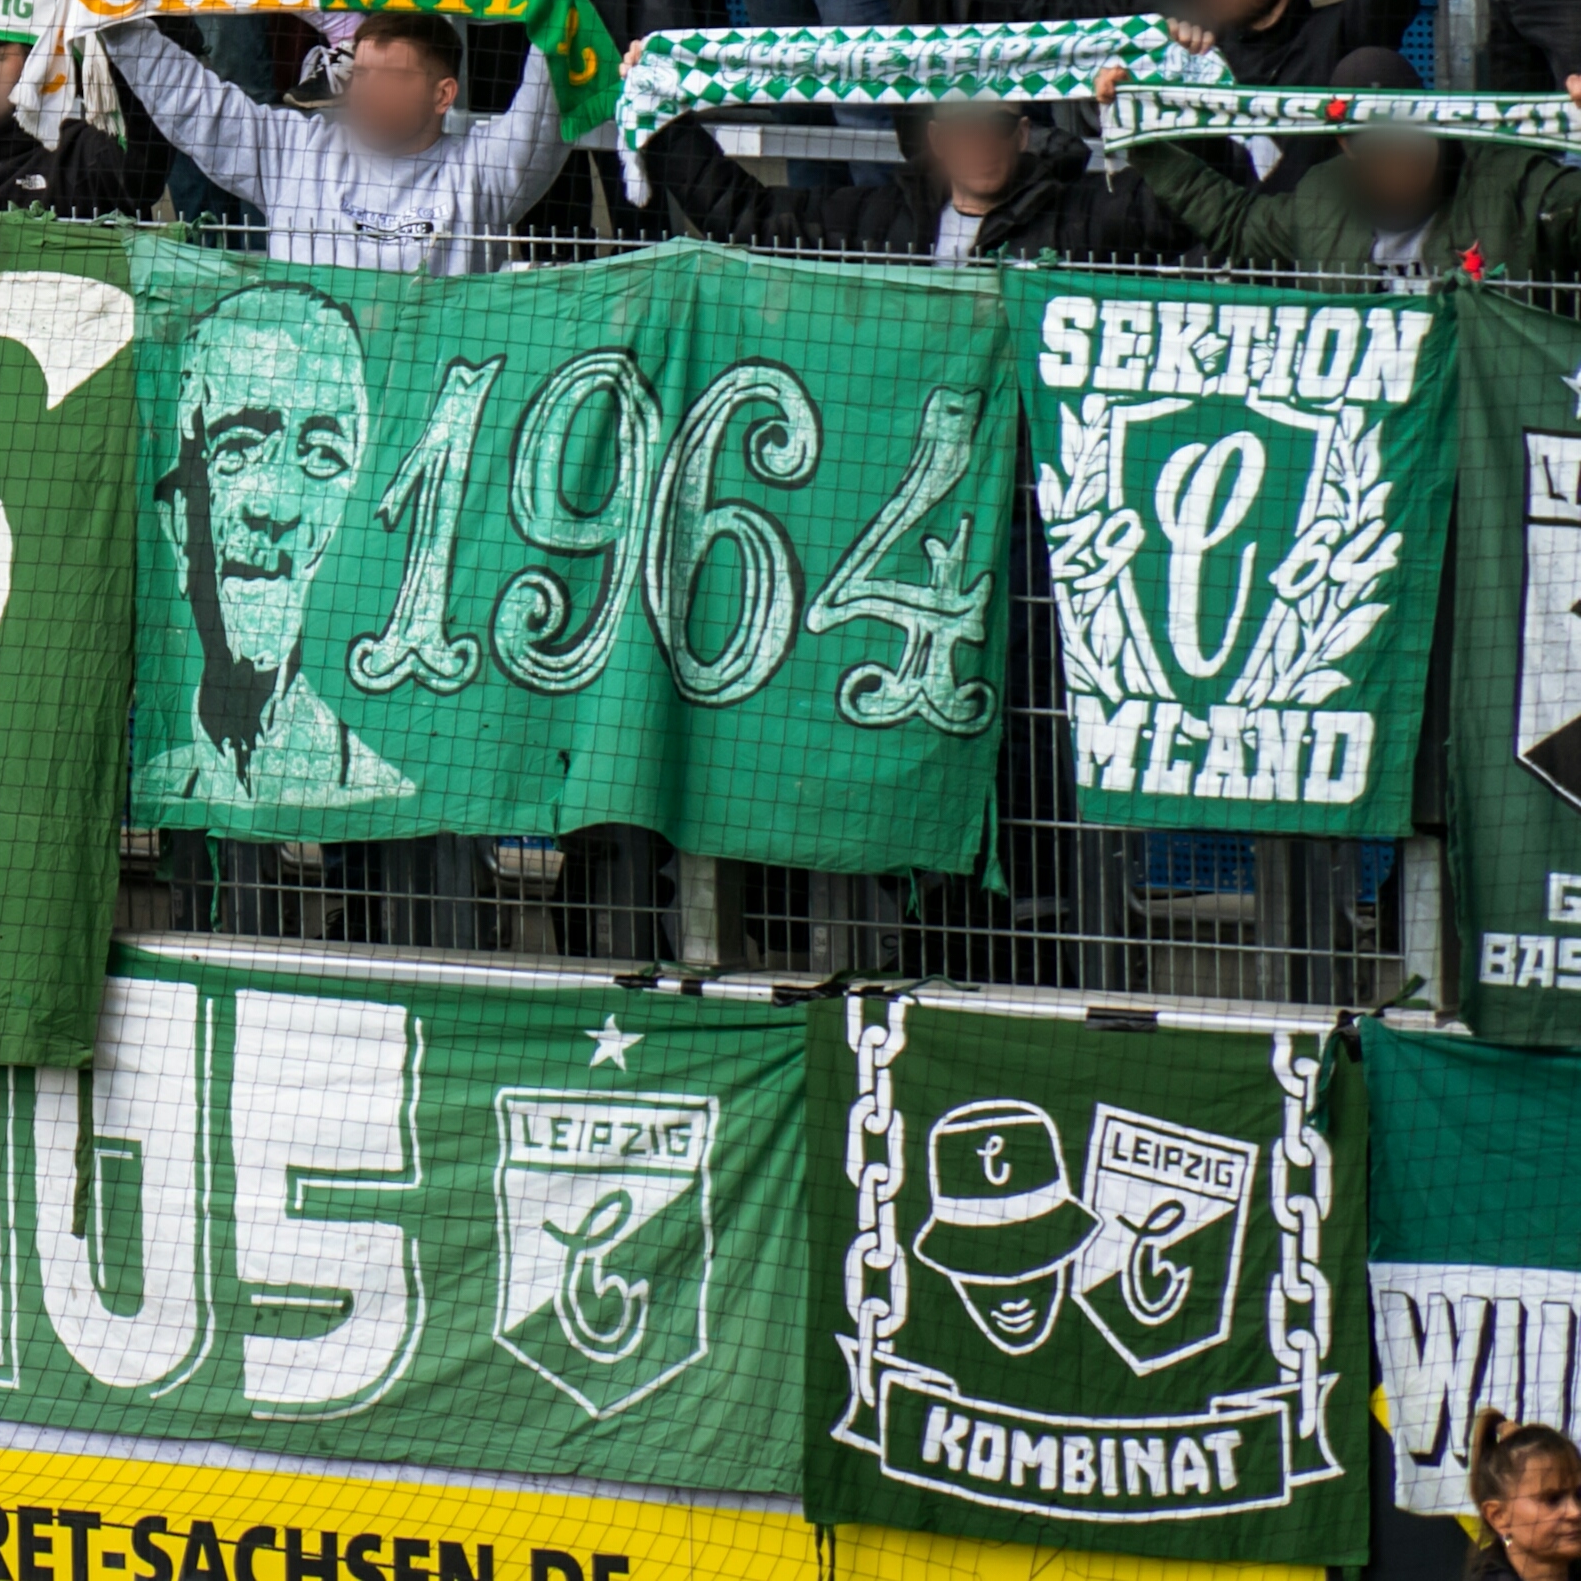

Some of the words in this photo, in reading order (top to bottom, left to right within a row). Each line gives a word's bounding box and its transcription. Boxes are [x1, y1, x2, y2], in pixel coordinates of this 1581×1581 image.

[1039, 295, 1434, 403] SEKTION
[346, 346, 1000, 740] 1964
[520, 1108, 694, 1162] LEIPZIG
[1110, 1128, 1237, 1192] LEIPZIG
[922, 1403, 1243, 1498] KOMBINAT
